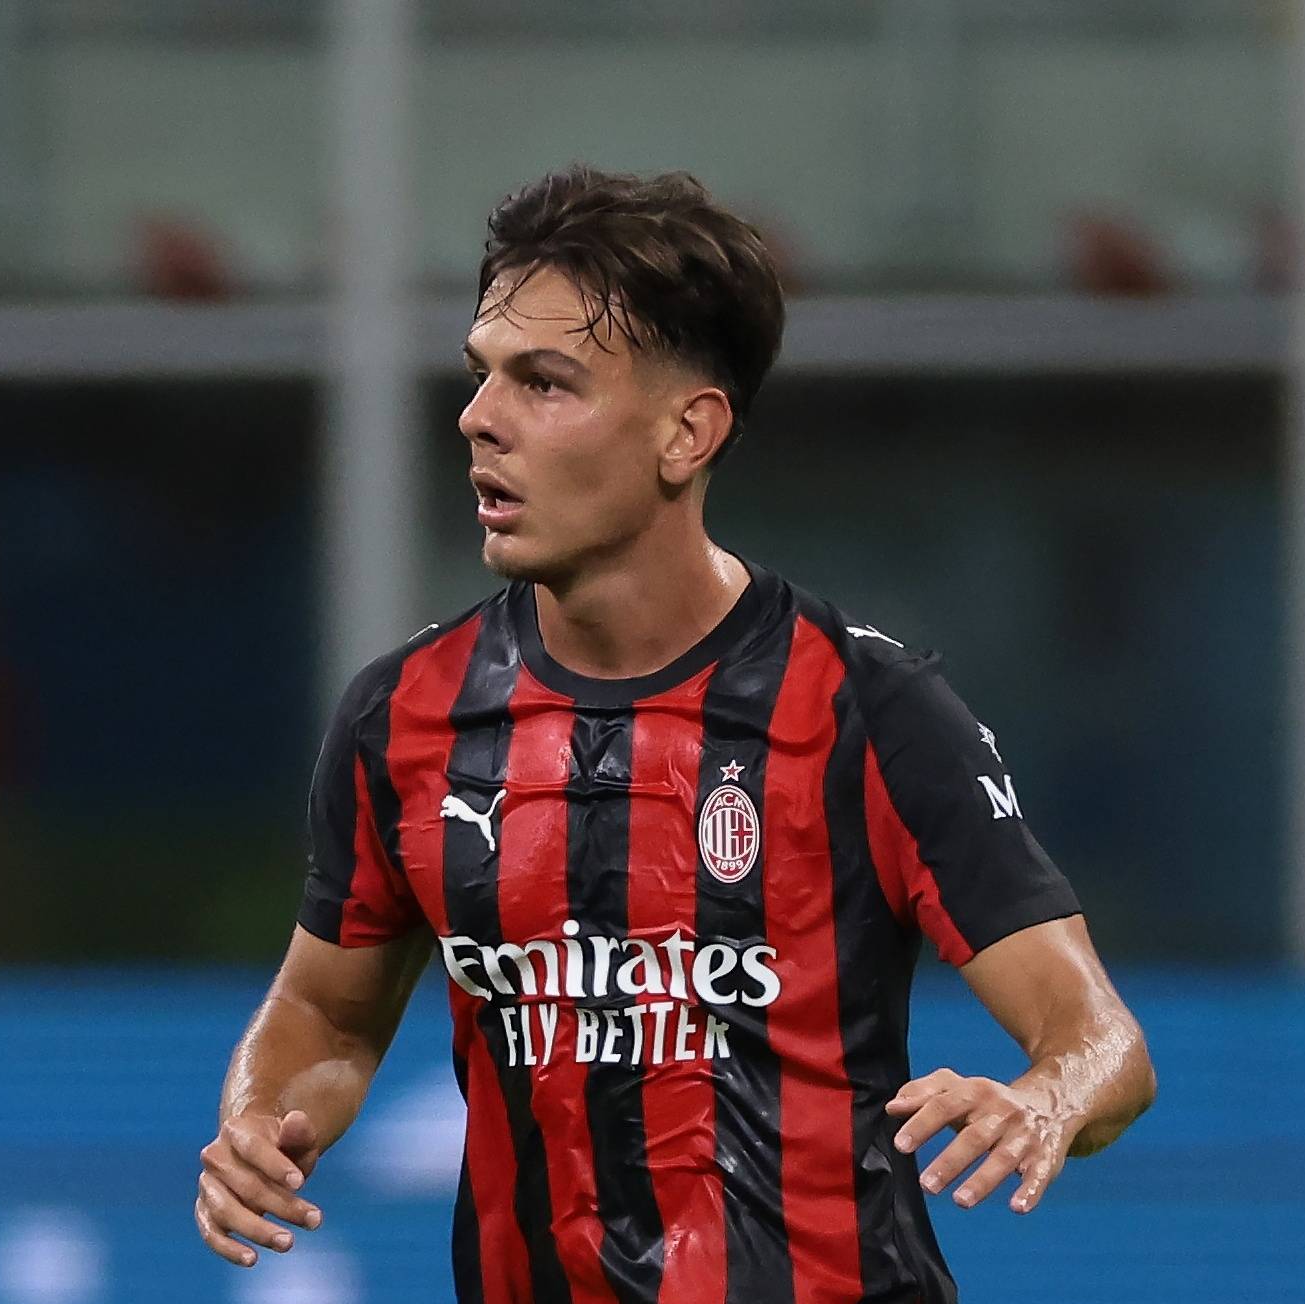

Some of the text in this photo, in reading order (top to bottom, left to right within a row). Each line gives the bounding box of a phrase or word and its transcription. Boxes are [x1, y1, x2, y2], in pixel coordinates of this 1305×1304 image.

[712, 793, 746, 812] ACM
[715, 859, 744, 871] 1899
[438, 919, 781, 1007] Emirates
[500, 1001, 732, 1067] FLY BETTER
